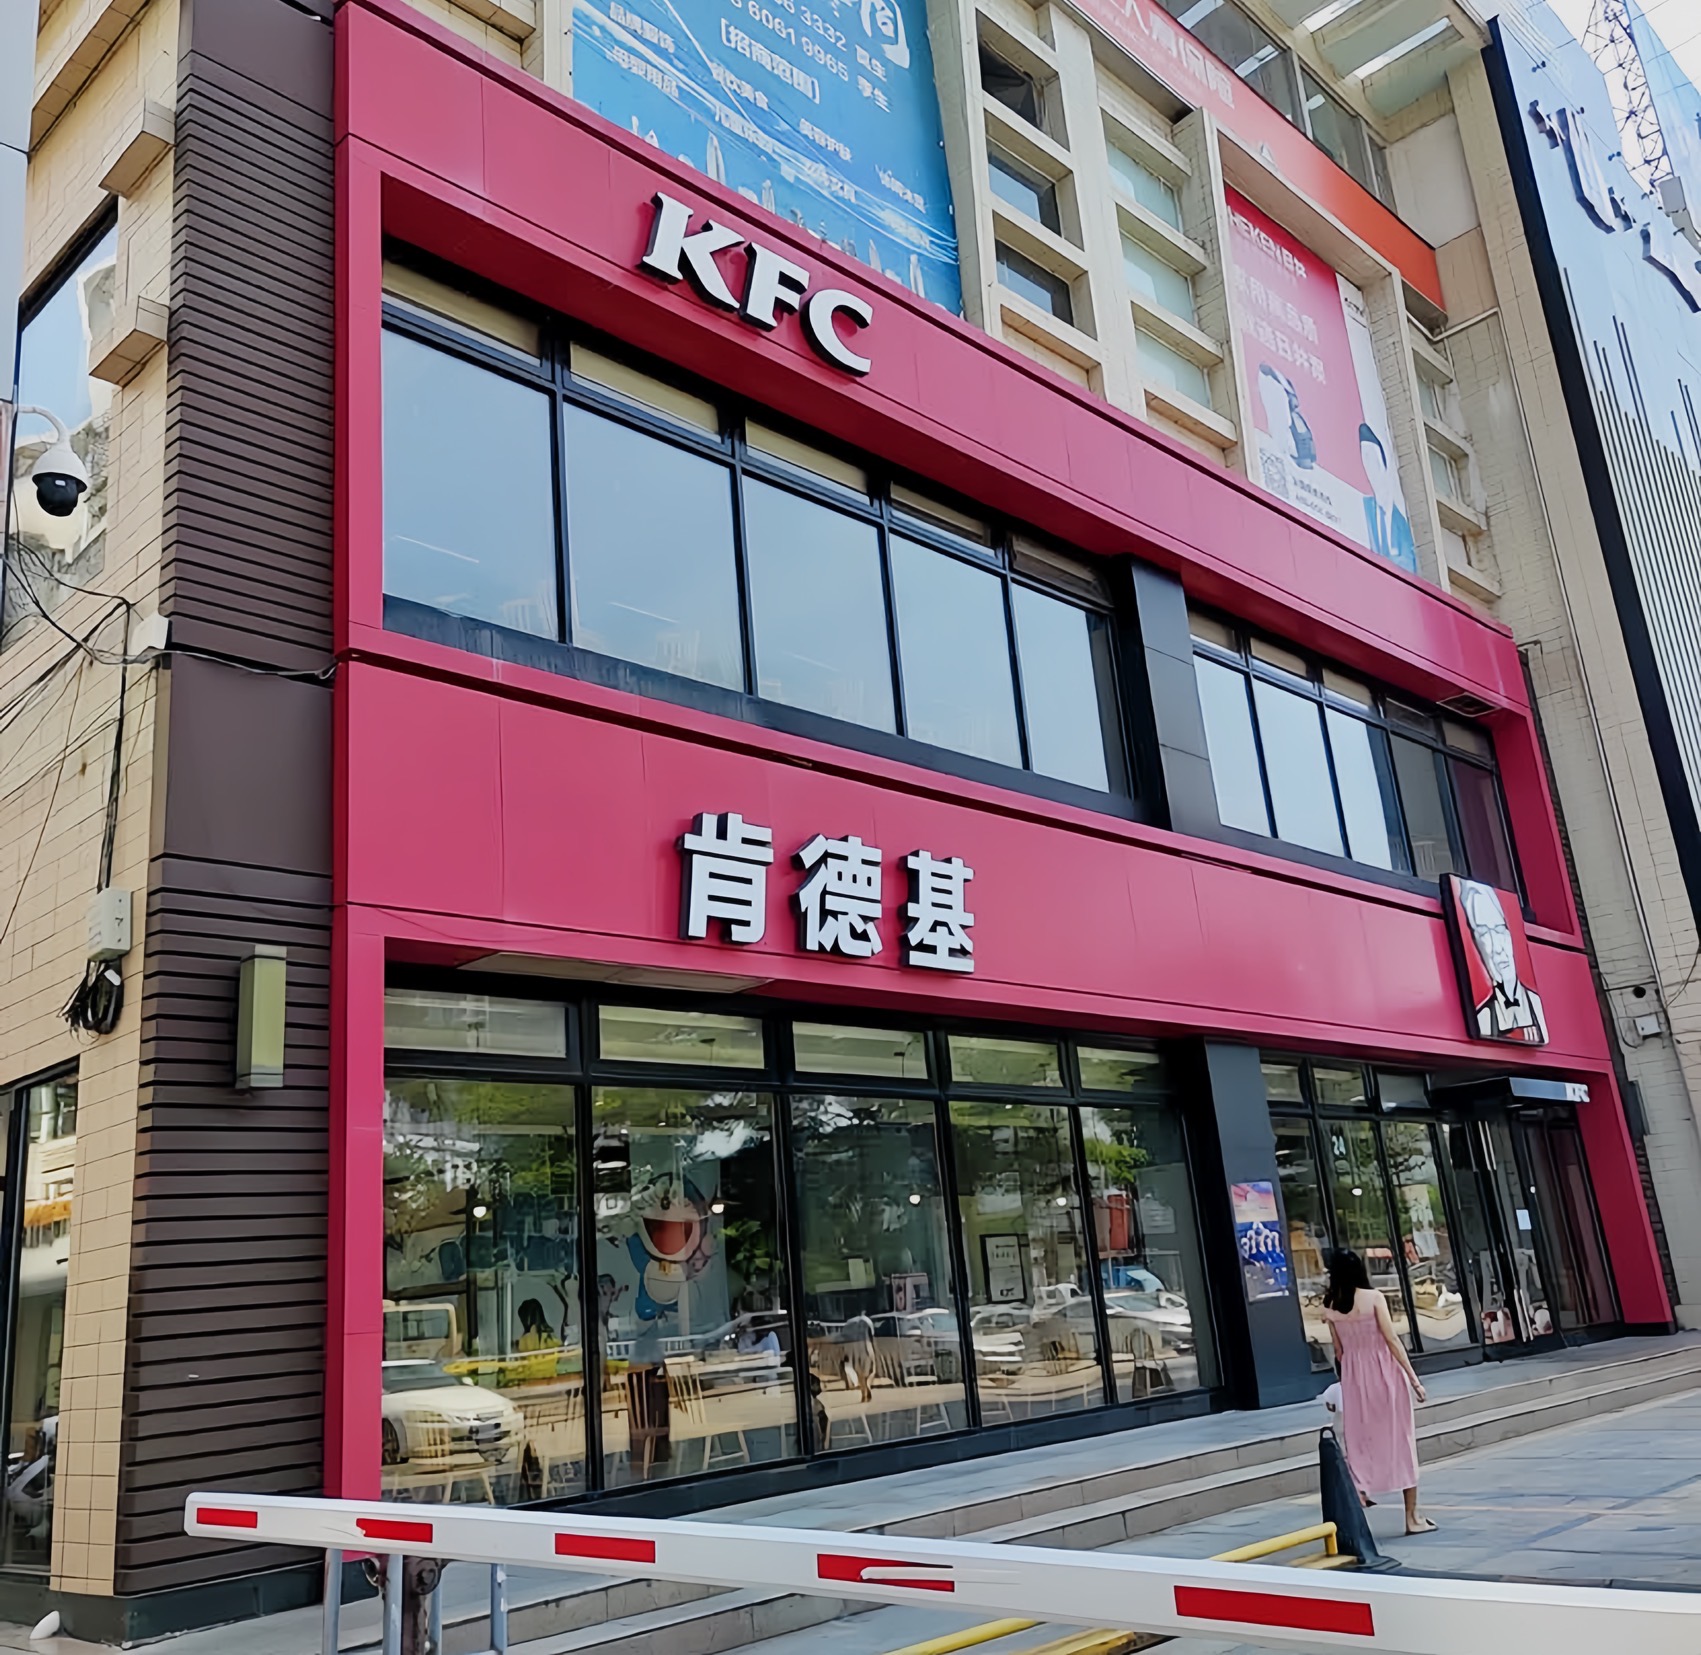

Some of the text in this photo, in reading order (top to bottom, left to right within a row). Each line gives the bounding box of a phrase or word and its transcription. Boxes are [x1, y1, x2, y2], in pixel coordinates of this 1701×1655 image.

[642, 191, 874, 374] KFC
[683, 811, 976, 973] 肯德基
